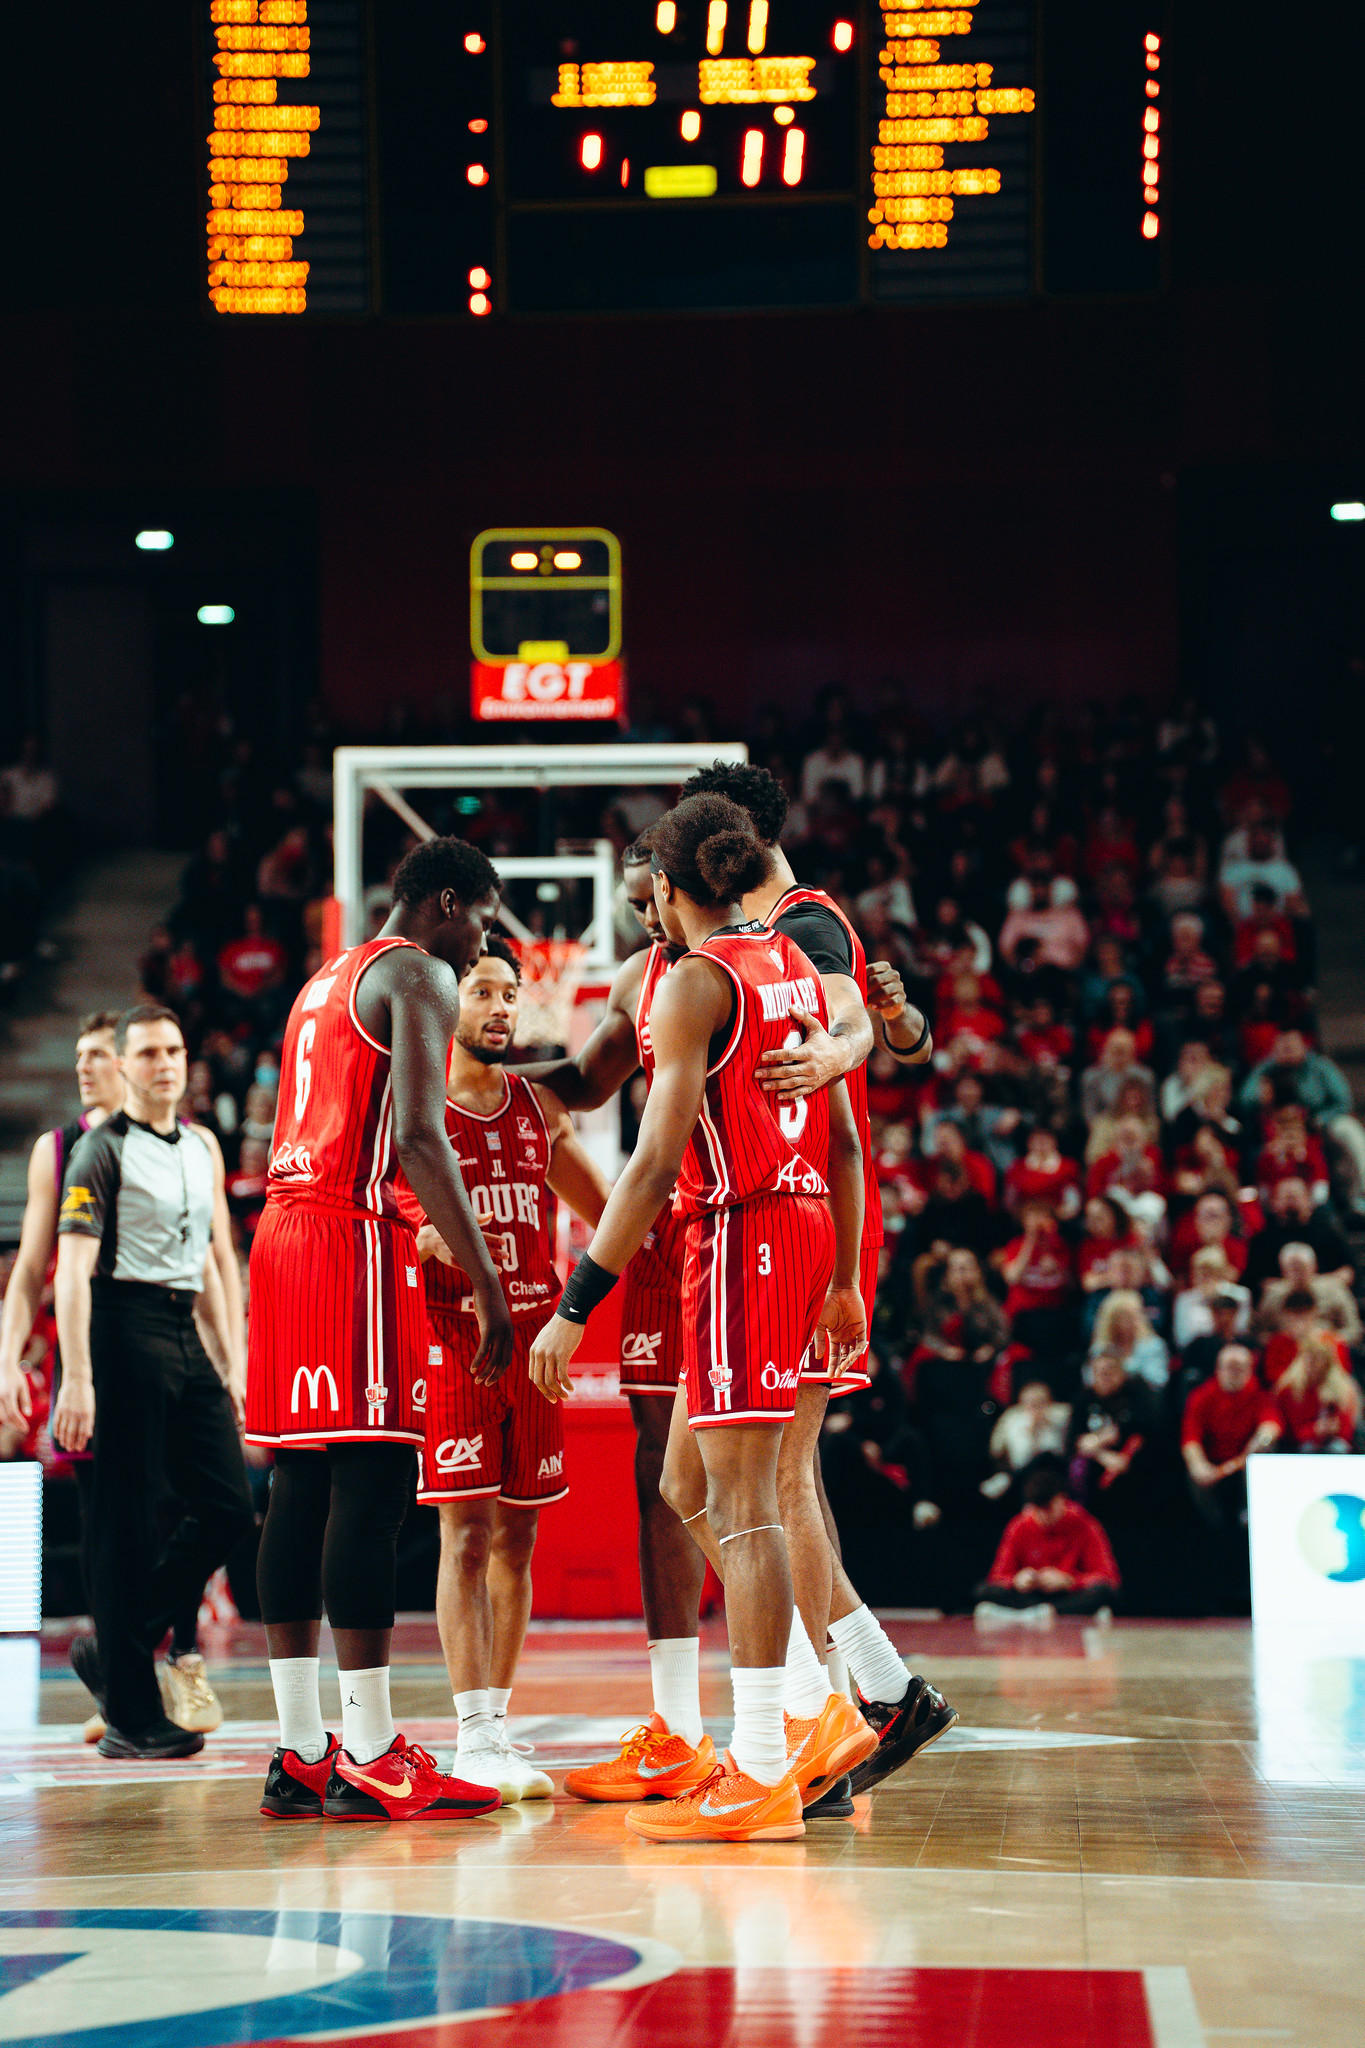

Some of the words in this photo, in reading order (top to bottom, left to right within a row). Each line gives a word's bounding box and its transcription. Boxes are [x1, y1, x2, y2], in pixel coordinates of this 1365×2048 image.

[294, 1017, 316, 1122] 6
[491, 1159, 506, 1178] JL
[467, 1183, 540, 1232] OURG
[758, 1243, 771, 1275] 3
